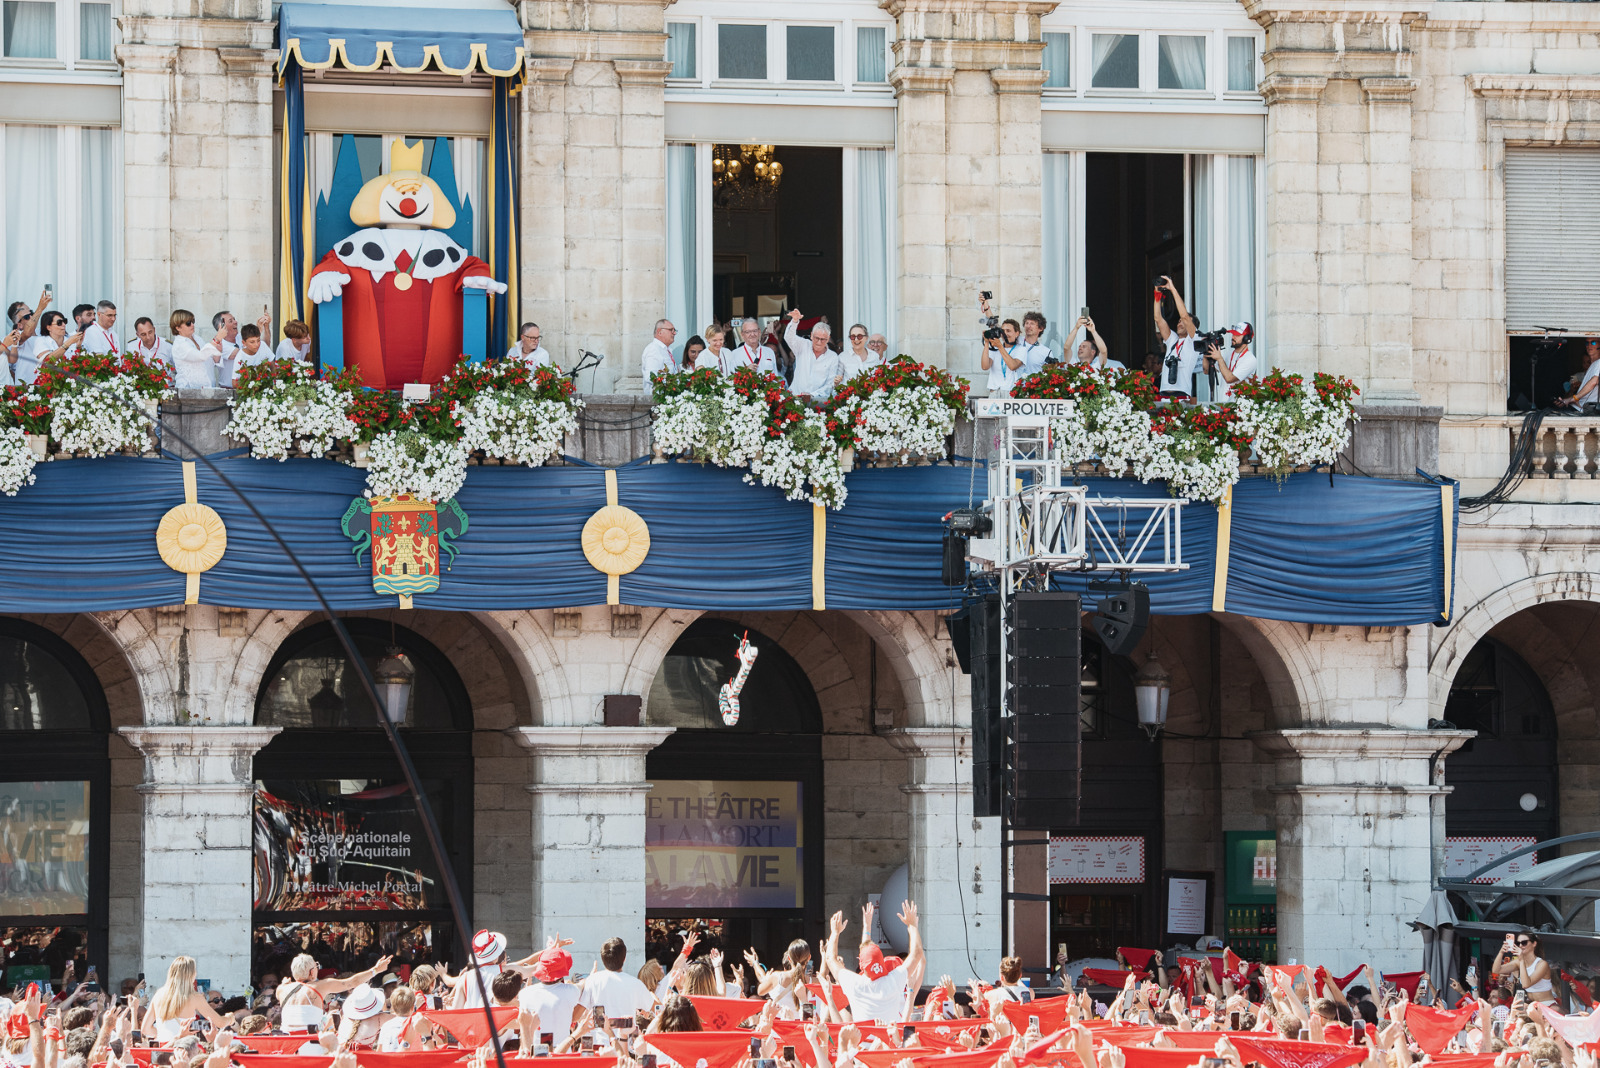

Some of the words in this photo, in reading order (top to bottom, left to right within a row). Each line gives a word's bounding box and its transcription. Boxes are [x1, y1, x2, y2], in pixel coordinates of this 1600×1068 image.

[1003, 402, 1064, 416] PROLYTE
[447, 498, 466, 521] OLLUTA
[667, 791, 780, 820] THÉÂTRE
[299, 830, 343, 843] Scène
[347, 831, 411, 843] nationale
[701, 824, 780, 848] MORT
[299, 845, 317, 857] du
[319, 845, 411, 859] Sud-Aquitain
[720, 854, 780, 888] VIE
[285, 880, 335, 892] Théâtre
[337, 881, 381, 892] Michel
[384, 881, 423, 892] Portal
